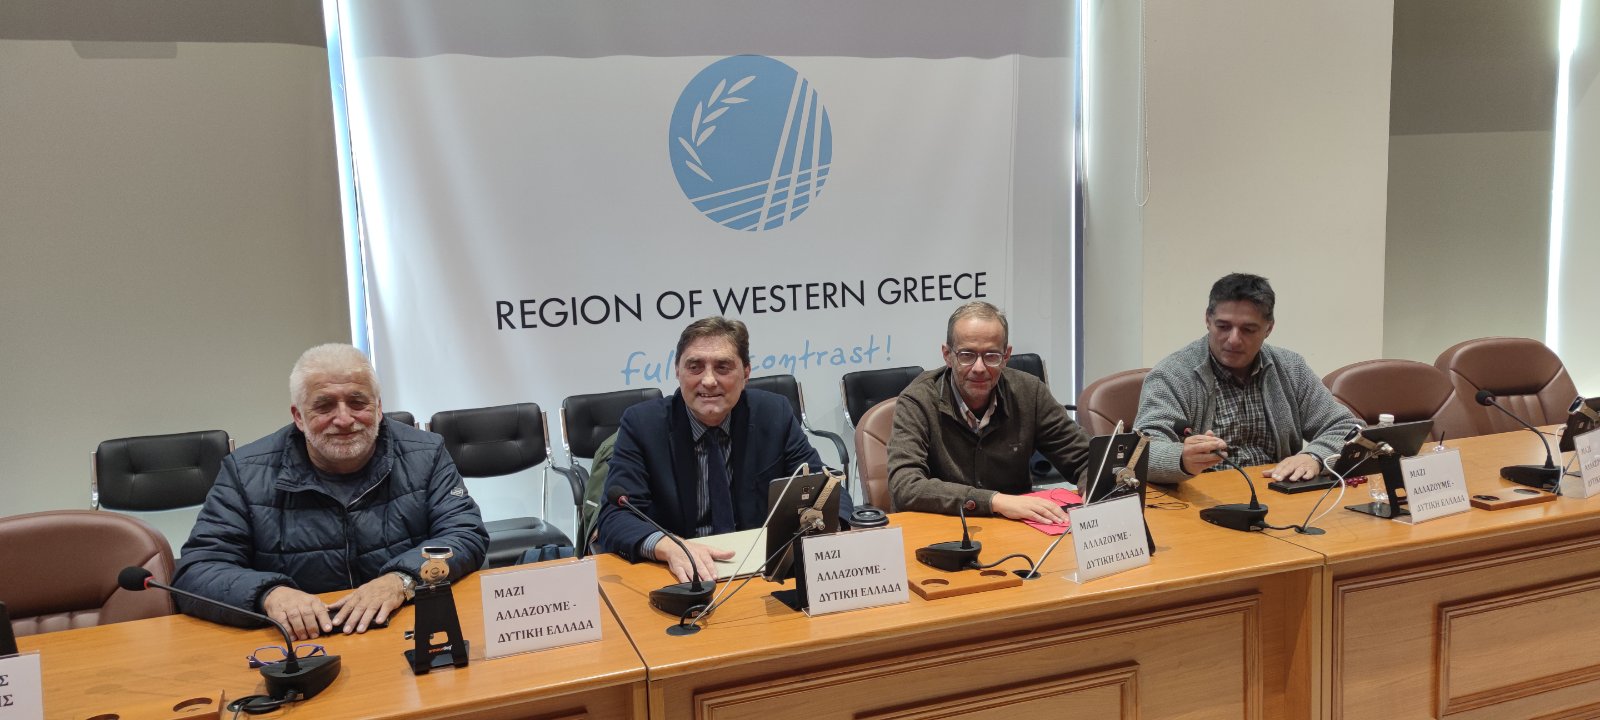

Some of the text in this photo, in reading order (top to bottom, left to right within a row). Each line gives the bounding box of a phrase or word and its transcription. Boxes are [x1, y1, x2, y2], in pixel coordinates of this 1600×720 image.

[496, 271, 987, 330] REGION OF WESTERN GREECE
[620, 350, 676, 386] ful
[1080, 520, 1098, 530] ΜΑΖΙ
[1084, 532, 1128, 550] ΑΛΛΑΖΟΥΜΕ
[814, 550, 840, 561] ΜΑΖΙ
[1086, 548, 1144, 569] ΔΥΤΙΚΗ ΕΛΛΑΔΑ
[818, 564, 880, 582] ΑΛΛΑΖΟΥΜΕ
[494, 586, 524, 598] ΜΑΖΙ
[820, 582, 901, 602] ΔΥΤΙΚΗ ΕΛΛΑΔΑ
[496, 600, 569, 621] ΑΛΛΑΖΟΥΜΕ
[498, 620, 593, 642] ΔΥΤΙΚΗ ΕΛΛΑΔΑ
